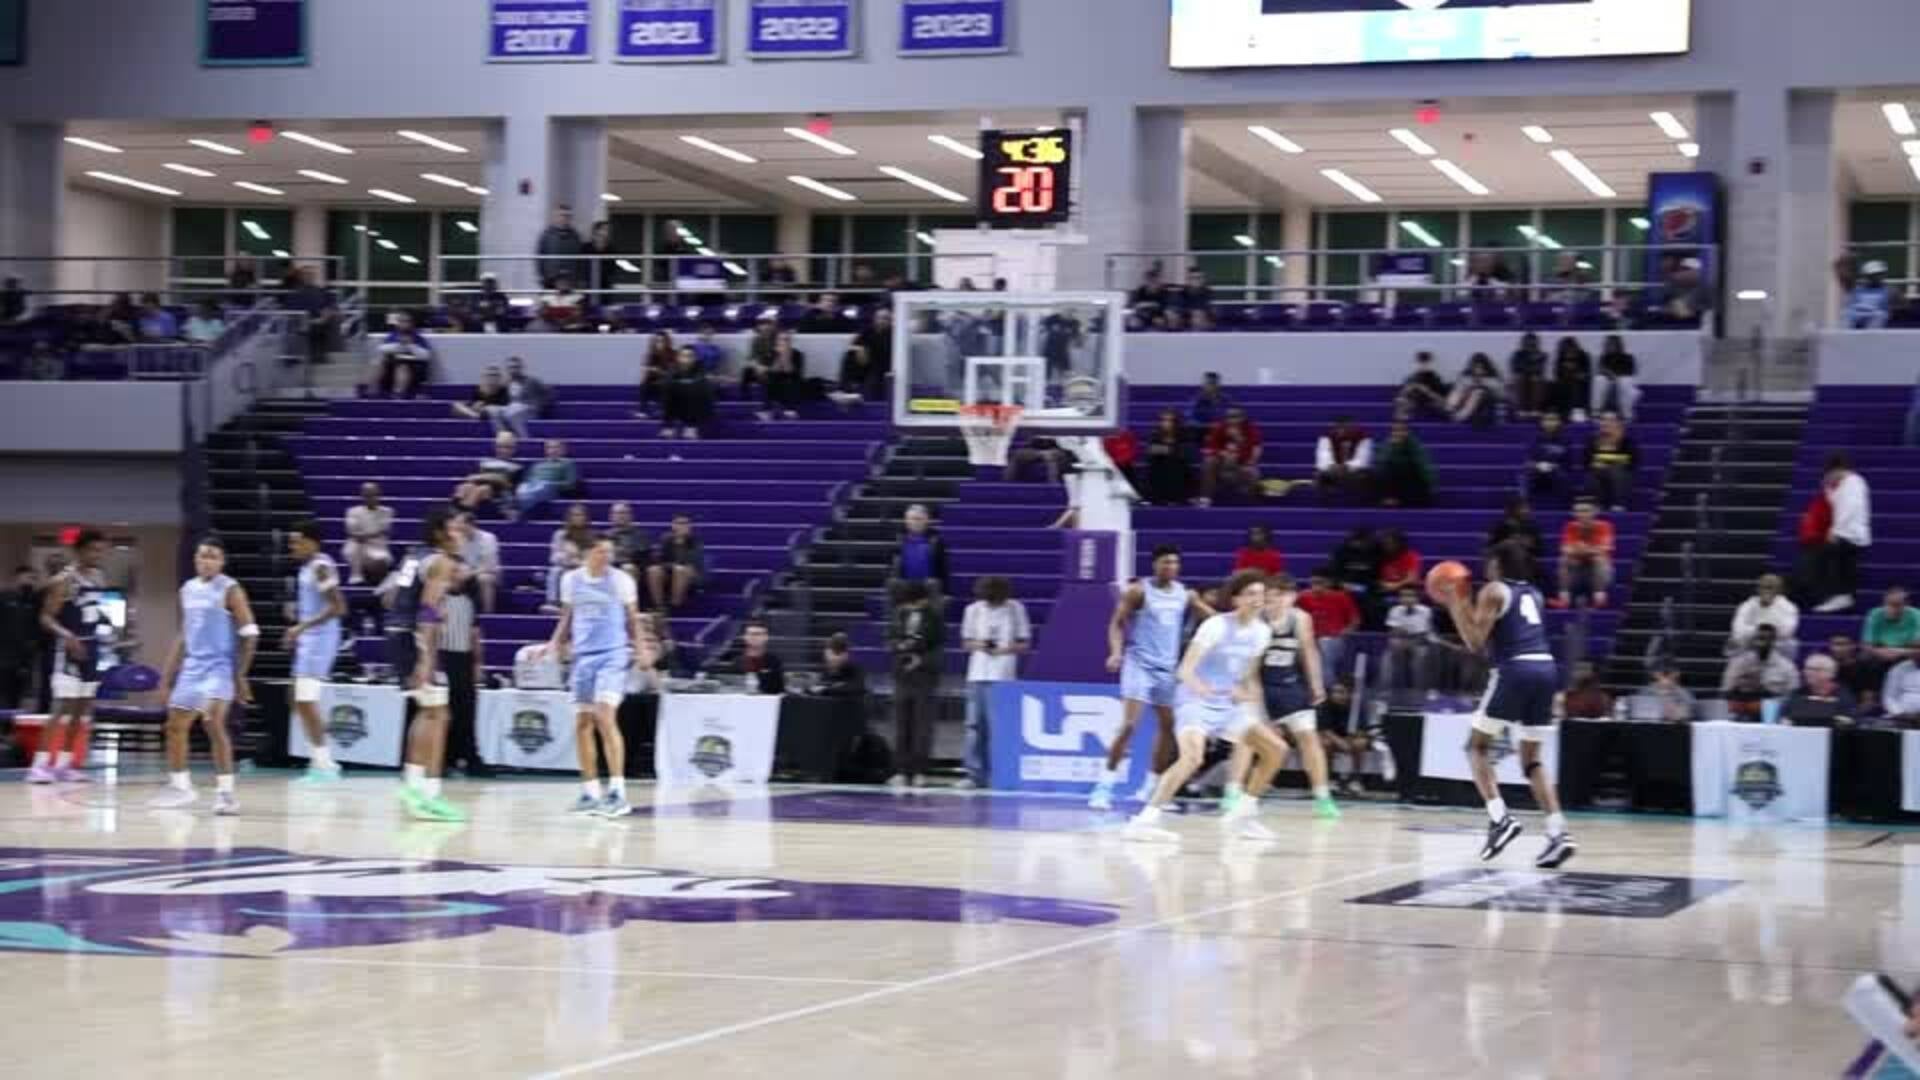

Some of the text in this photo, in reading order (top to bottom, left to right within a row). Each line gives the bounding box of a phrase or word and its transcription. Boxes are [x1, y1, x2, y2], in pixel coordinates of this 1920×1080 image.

[629, 21, 703, 45] 2021
[760, 17, 838, 41] 2022
[911, 13, 992, 38] 2023
[993, 166, 1053, 212] 20
[1519, 593, 1541, 624] 4
